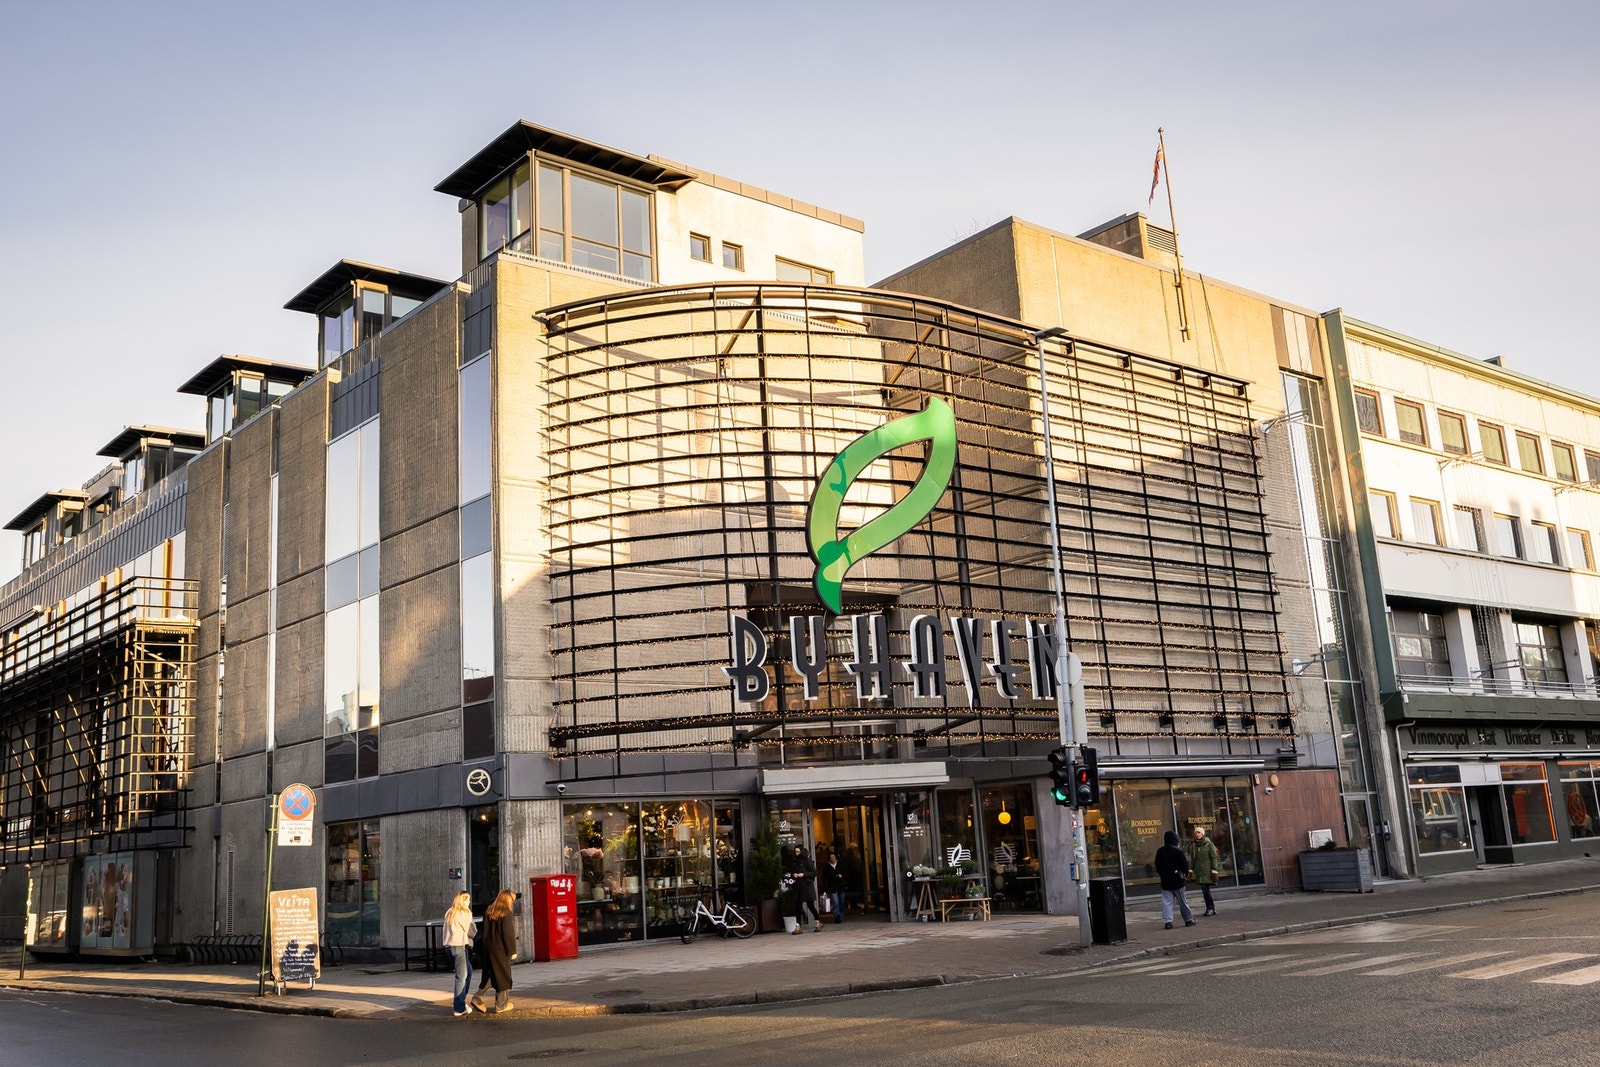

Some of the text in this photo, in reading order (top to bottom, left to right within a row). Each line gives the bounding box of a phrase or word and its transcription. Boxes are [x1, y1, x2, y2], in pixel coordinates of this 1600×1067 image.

[721, 614, 1058, 710] BYHAVEN
[1408, 727, 1470, 749] Vinmonopol
[1504, 728, 1541, 746] Urmaker
